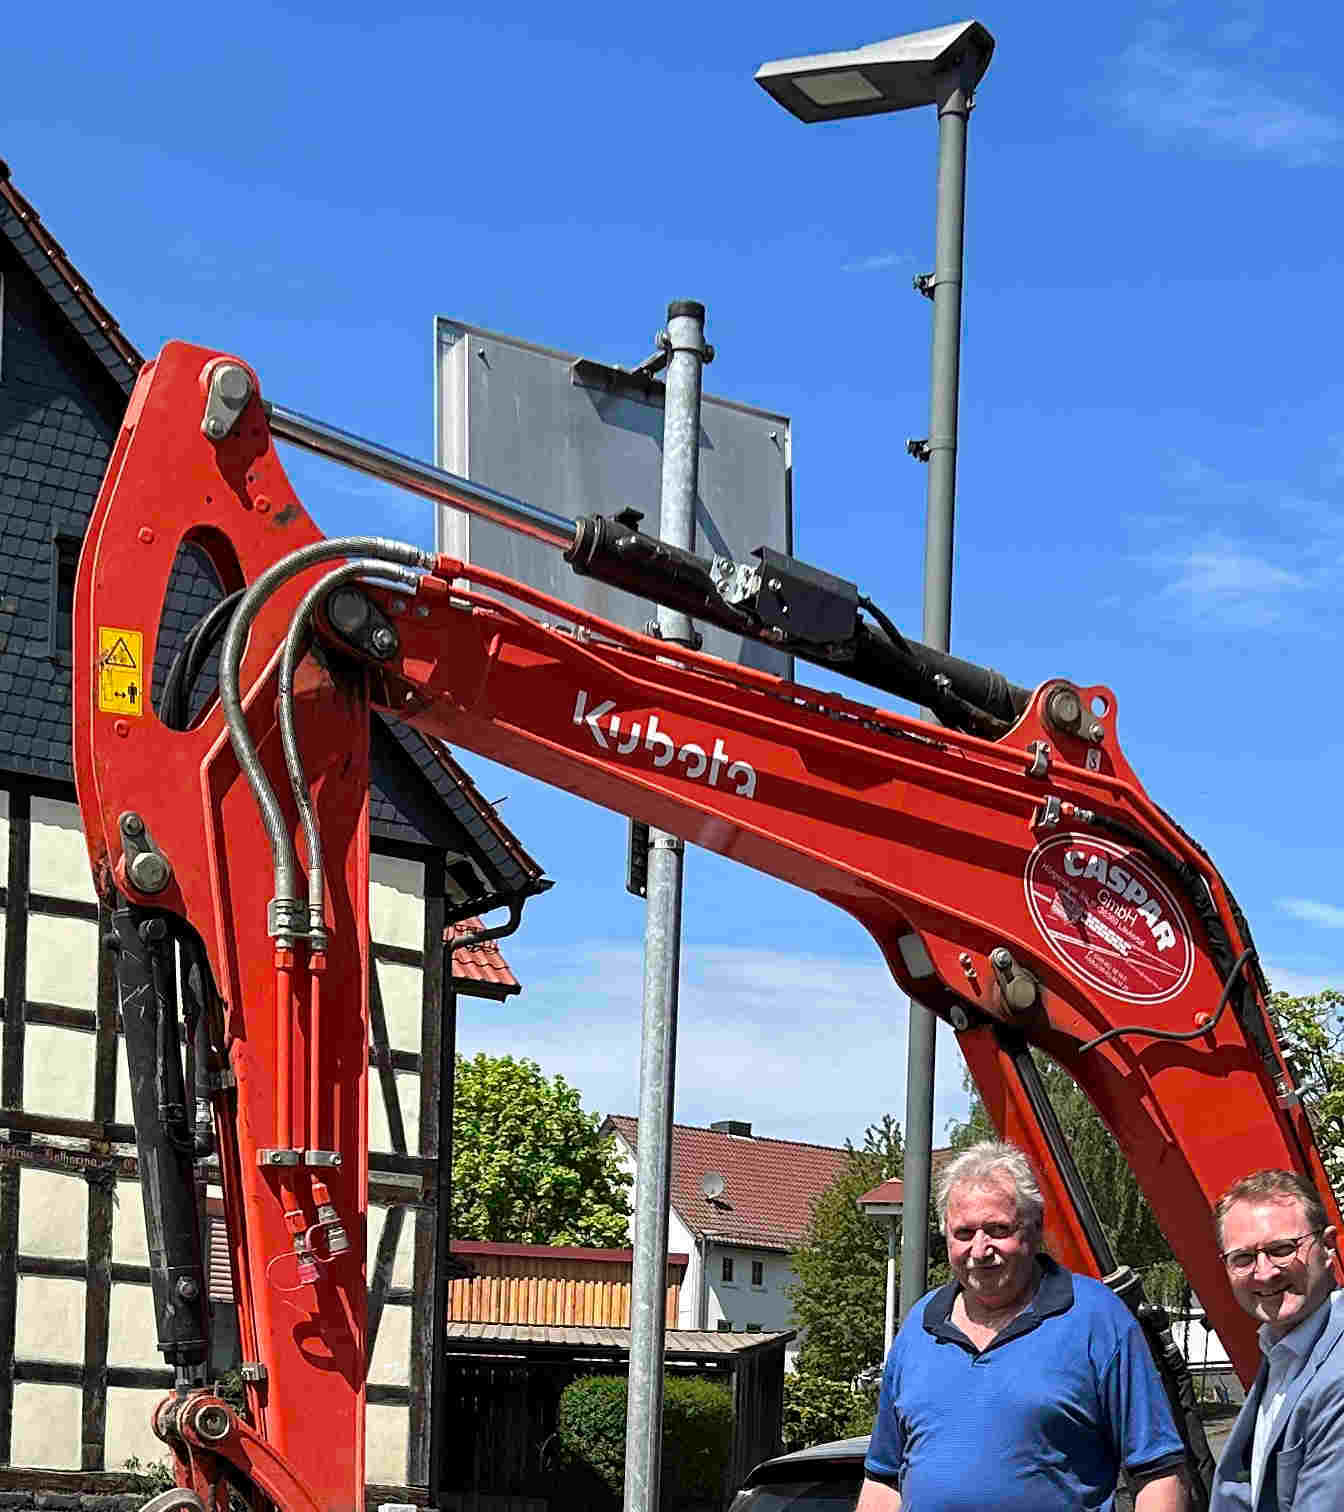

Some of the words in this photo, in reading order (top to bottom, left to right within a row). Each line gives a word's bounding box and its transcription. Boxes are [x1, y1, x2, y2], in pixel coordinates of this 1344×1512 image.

[573, 690, 757, 799] Kubota
[1064, 851, 1176, 952] CASPAR
[1097, 888, 1138, 927] GmbH
